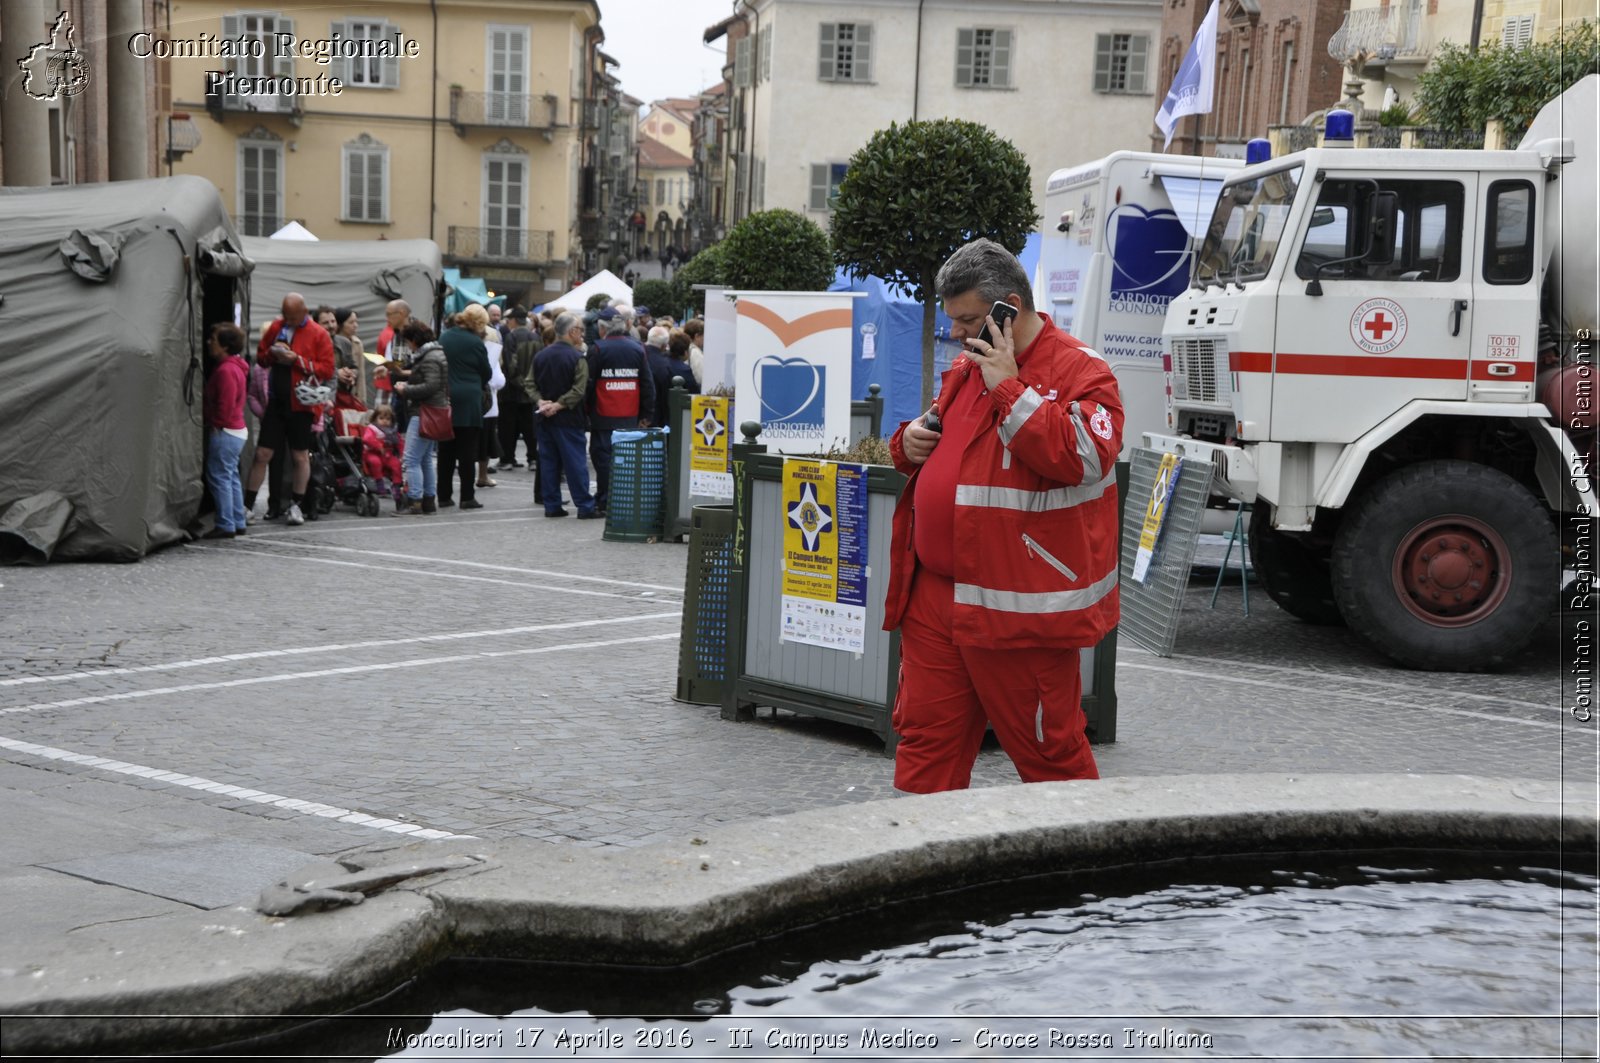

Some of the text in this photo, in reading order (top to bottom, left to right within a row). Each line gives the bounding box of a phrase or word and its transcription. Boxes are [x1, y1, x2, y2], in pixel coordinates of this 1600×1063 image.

[1353, 300, 1405, 328] CROCE ROSSA ITALIANA
[1360, 338, 1397, 352] MONCALIERI
[1491, 336, 1516, 346] TO 10
[1491, 347, 1515, 357] 33-21
[760, 422, 825, 432] CARDIOTEAM
[760, 430, 825, 439] FOUNDATION
[793, 552, 813, 562] Campus
[814, 554, 833, 565] Medico
